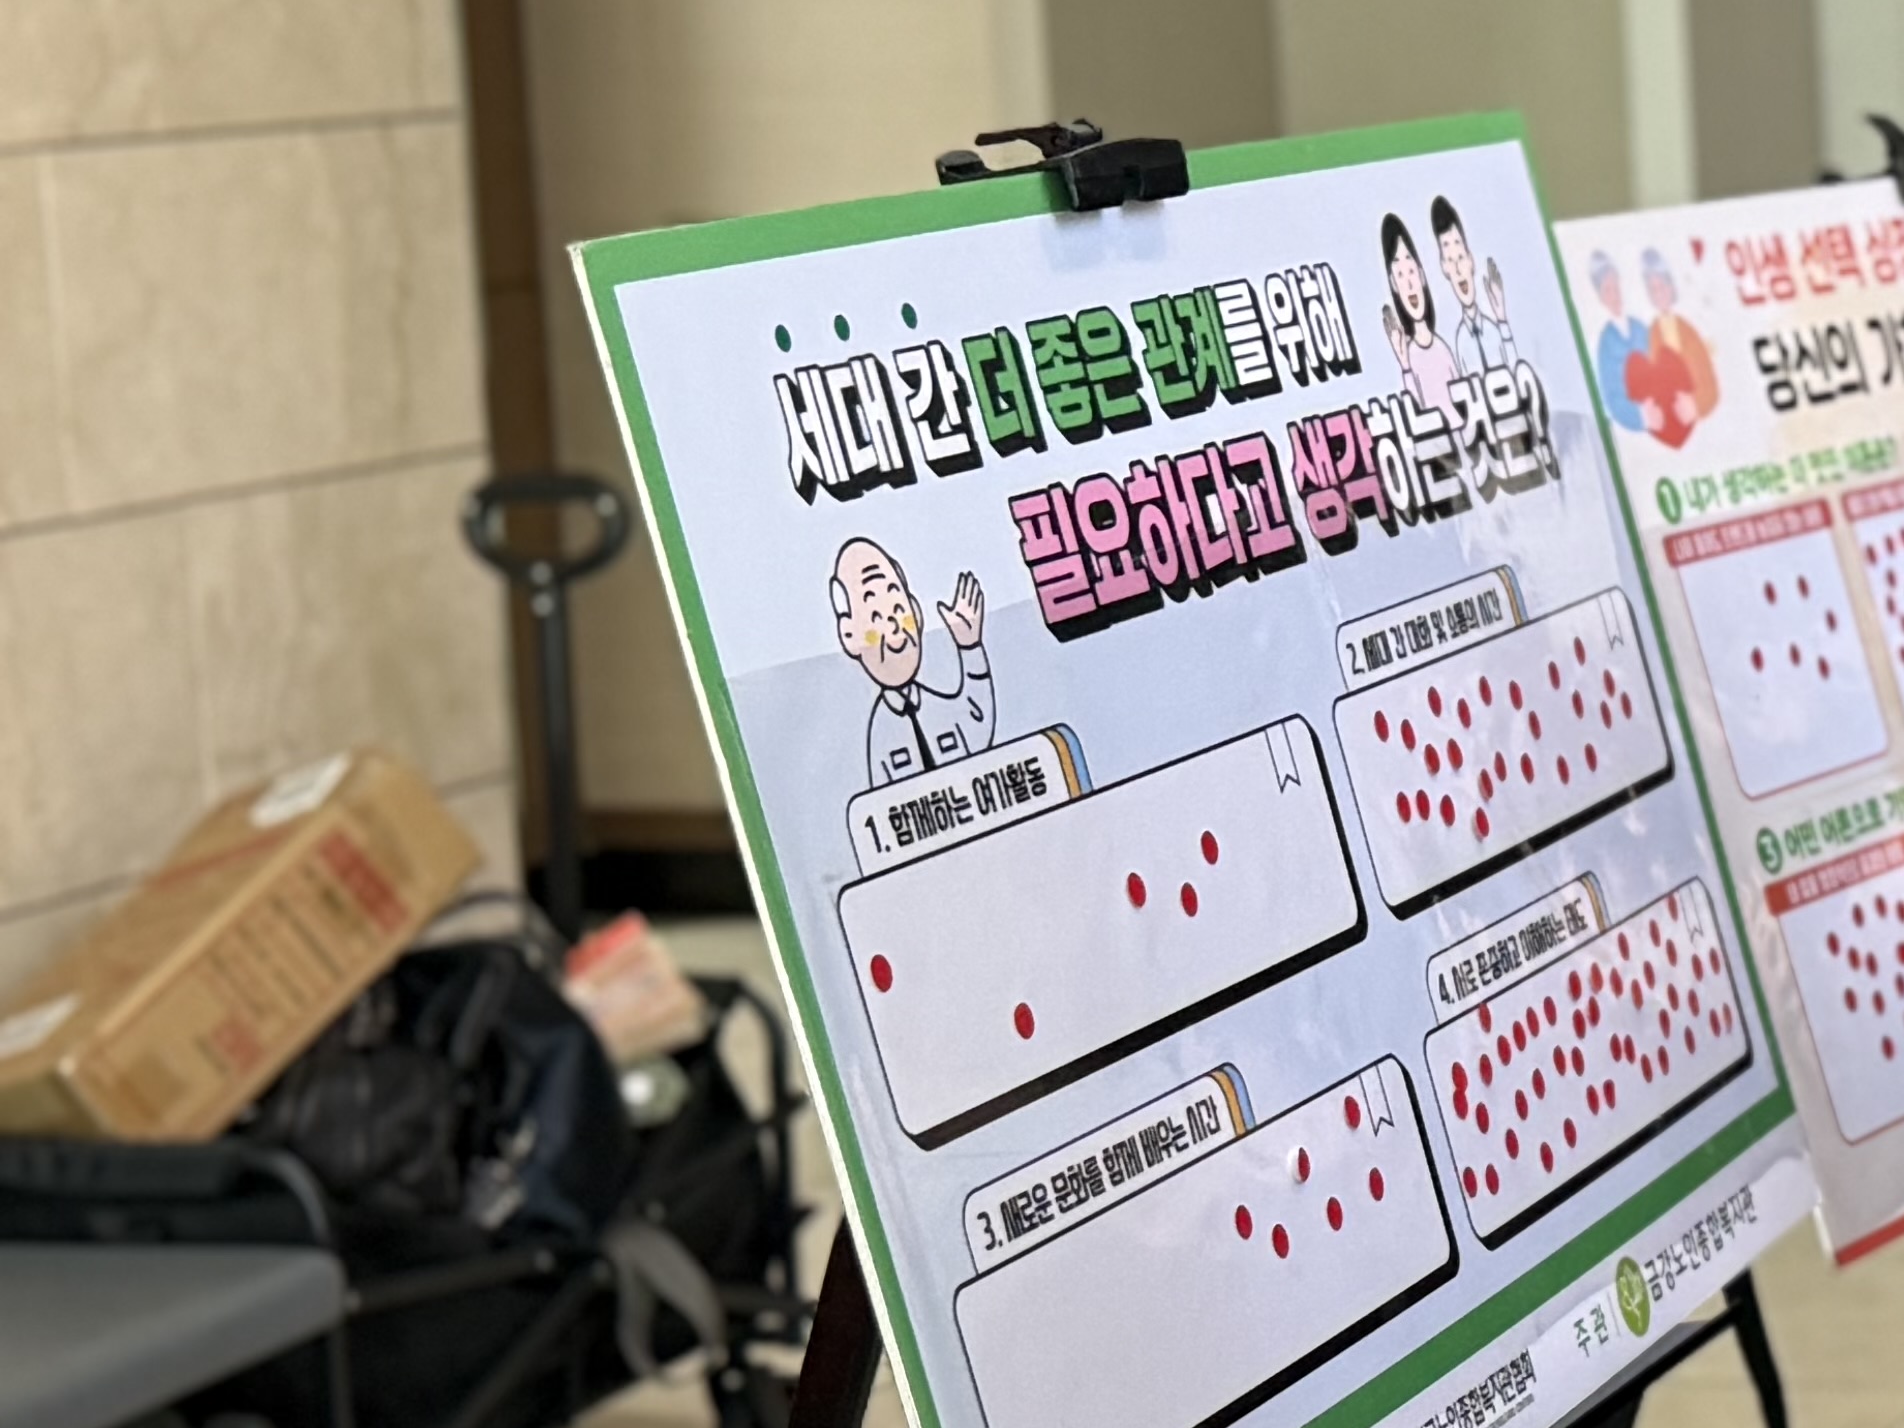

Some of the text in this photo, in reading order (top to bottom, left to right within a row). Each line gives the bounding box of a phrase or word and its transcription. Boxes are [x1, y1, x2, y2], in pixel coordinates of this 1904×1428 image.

[1724, 233, 1797, 306] 인생
[1799, 224, 1867, 295] 선택
[774, 262, 1361, 504] 세대 간 더 좋은 관계를 위해
[1751, 318, 1870, 413] 당신의
[1008, 430, 1306, 642] 필요하다고
[1287, 390, 1472, 556] 생각하는
[1450, 358, 1561, 503] 것은?
[1346, 587, 1503, 675] 2. 세대 간 대화 및 소통의 시간
[864, 756, 1047, 853] 1. 함께하는 여가활동
[1784, 819, 1821, 857] 어떤
[1438, 897, 1588, 1004] 4. 서로 존중하고 이해하는 태도
[977, 1095, 1221, 1251] 3. 새로운 문화를 함께 배우는 시간
[1643, 1183, 1758, 1302] 금강노인종합복지관
